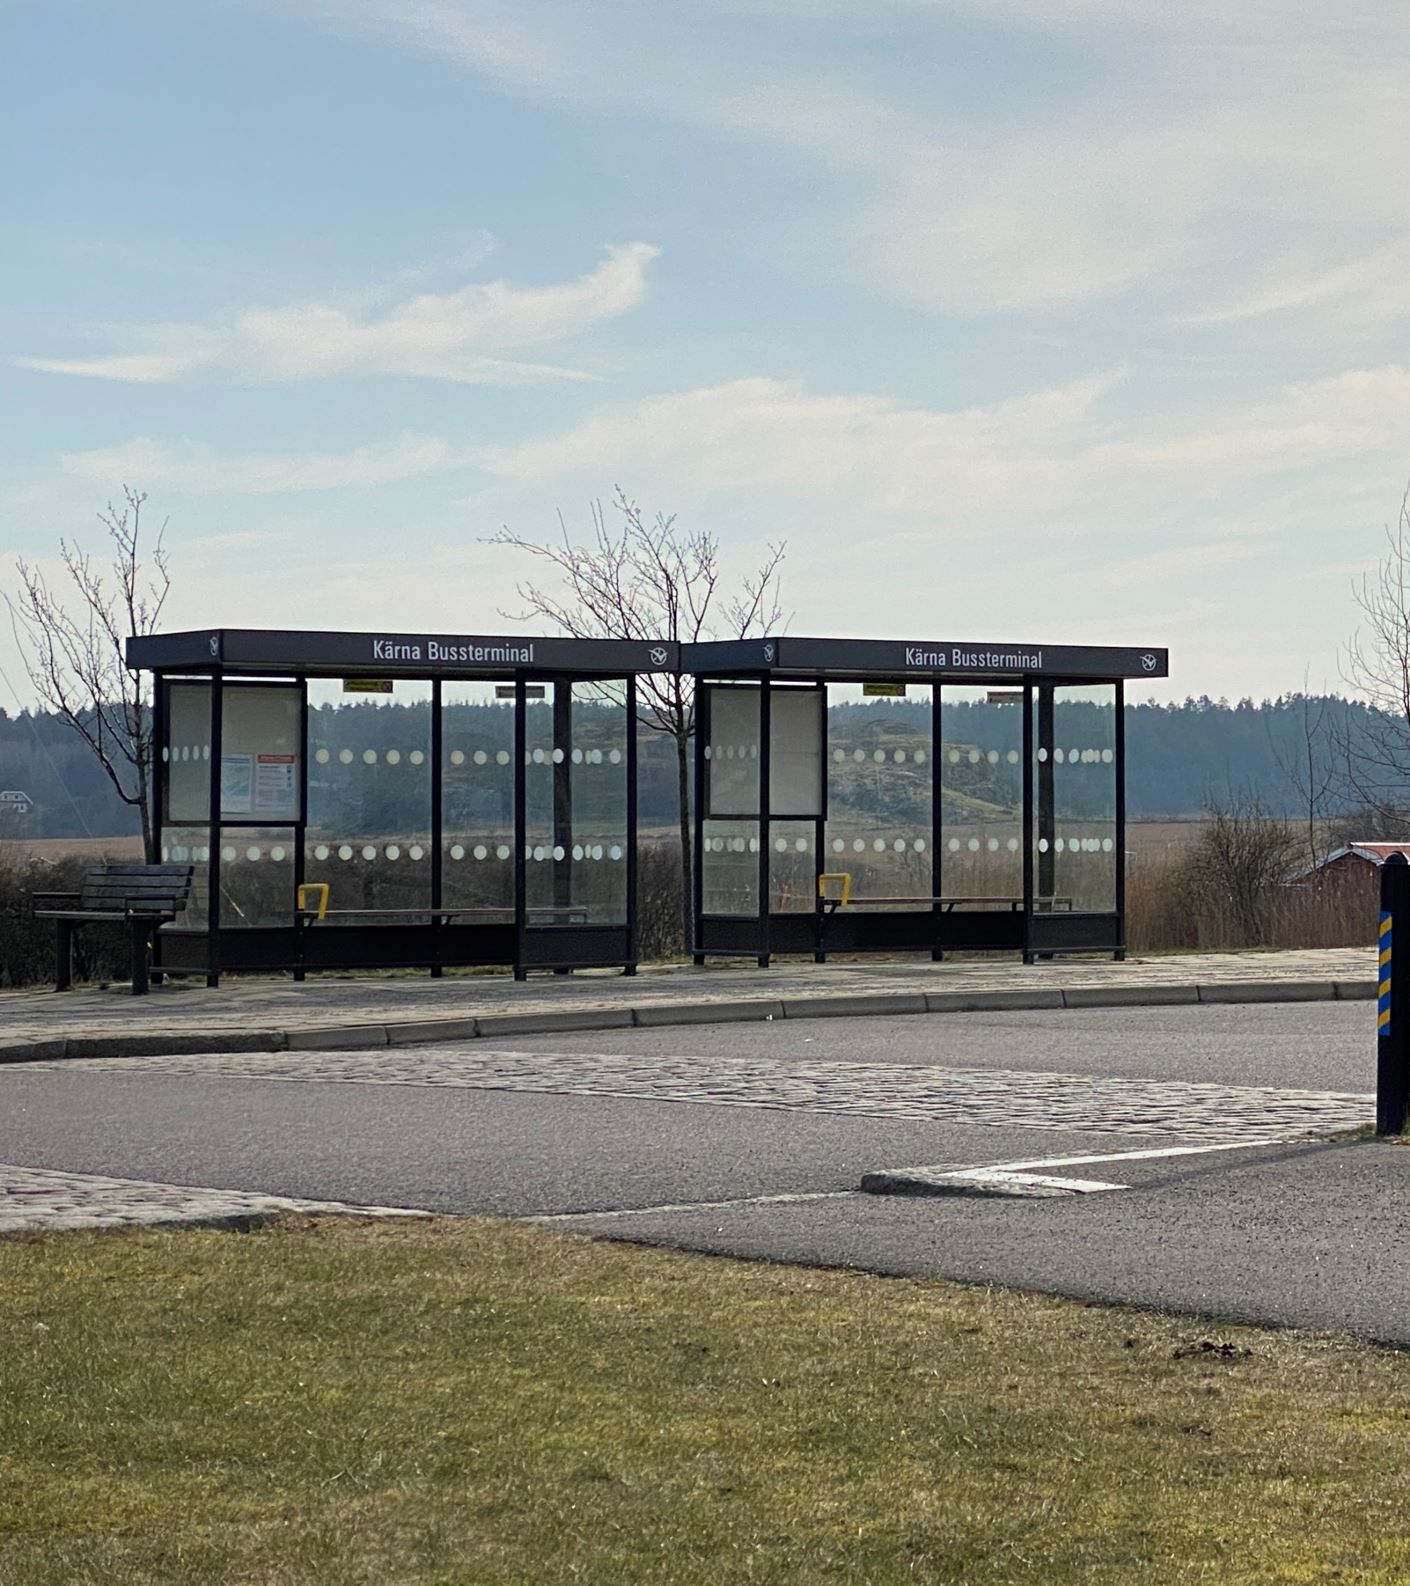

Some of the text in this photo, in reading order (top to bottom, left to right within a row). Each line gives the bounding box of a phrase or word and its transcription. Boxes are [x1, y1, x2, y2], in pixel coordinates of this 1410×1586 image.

[373, 639, 534, 663] Kärna Bussterminal
[905, 647, 1042, 669] Kärna Bussterminal
